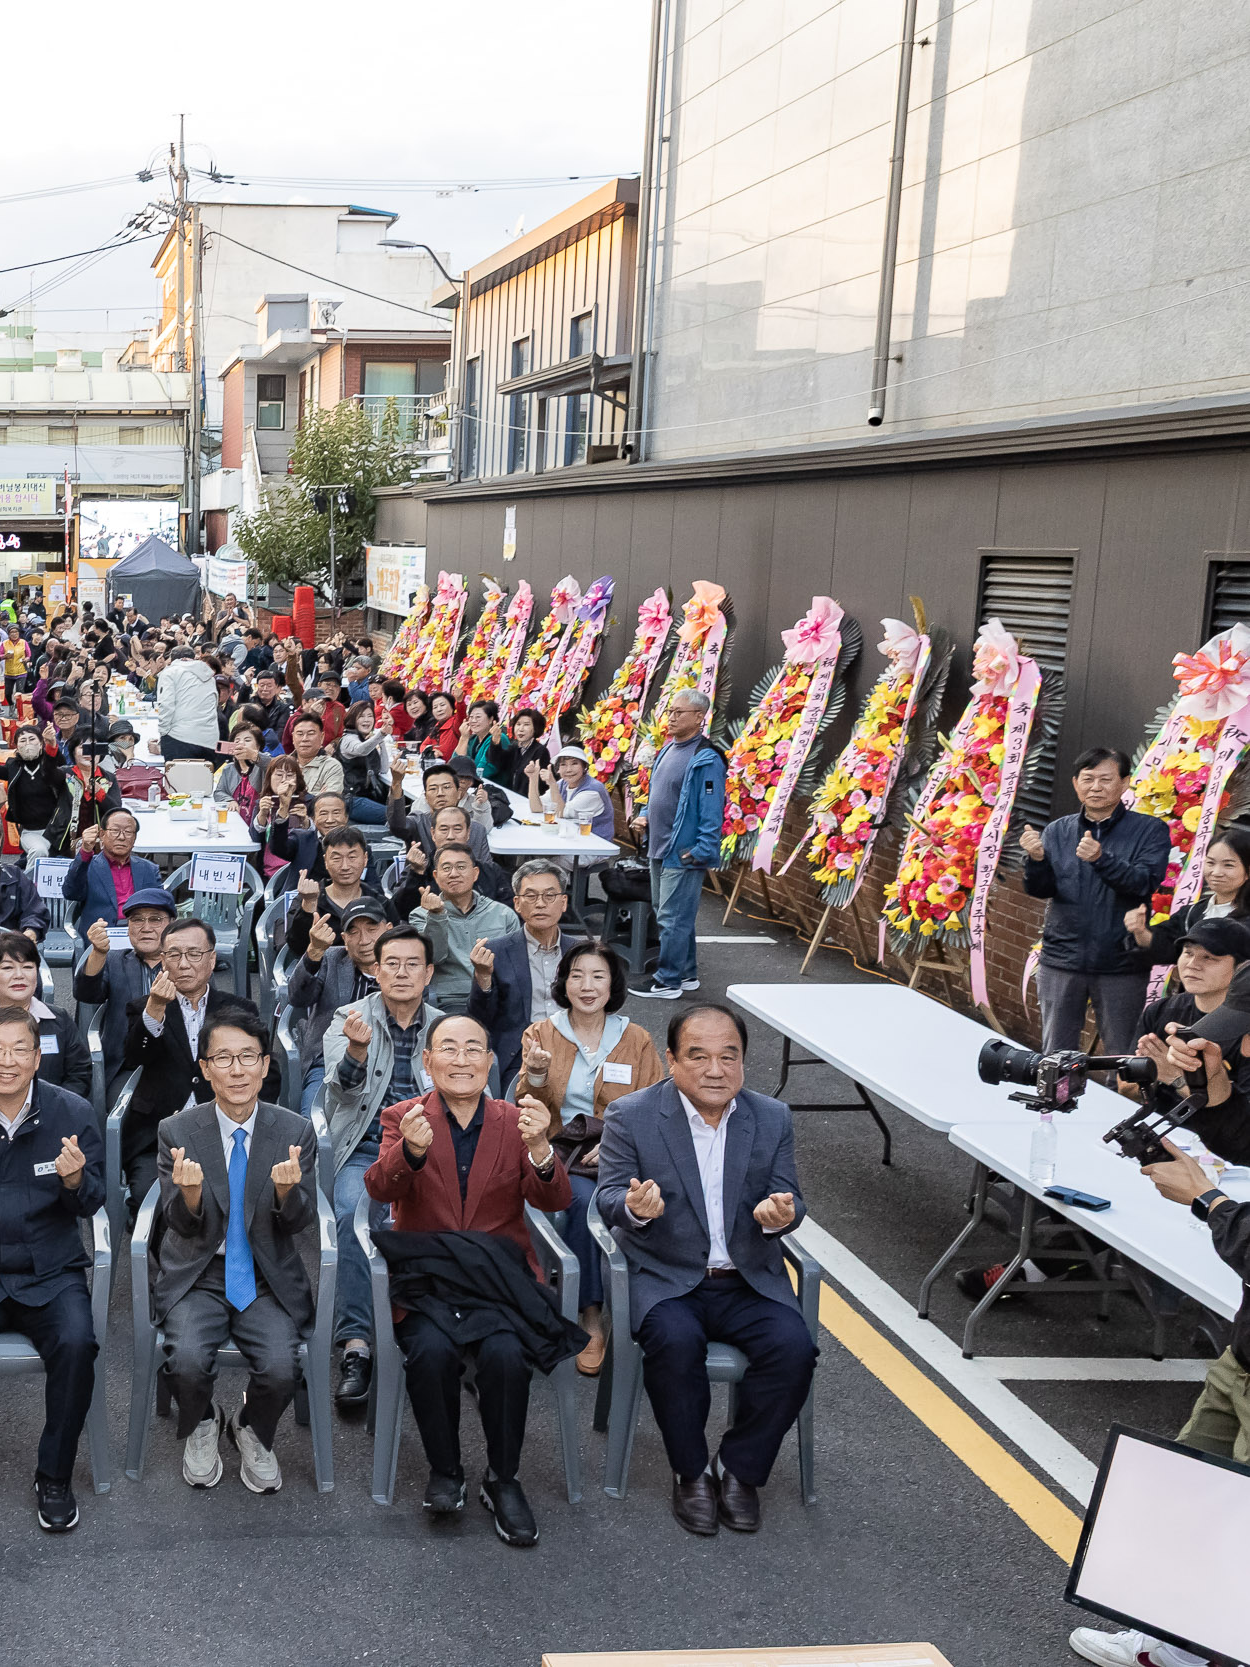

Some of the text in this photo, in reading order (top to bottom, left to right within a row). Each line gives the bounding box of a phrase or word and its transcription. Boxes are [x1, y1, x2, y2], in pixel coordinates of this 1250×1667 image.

[14, 493, 39, 503] 합시다
[811, 670, 831, 702] 제3회
[1206, 748, 1235, 797] 제3회
[970, 701, 1031, 953] 축 제3회 중곡제일시장 황금맥주축제
